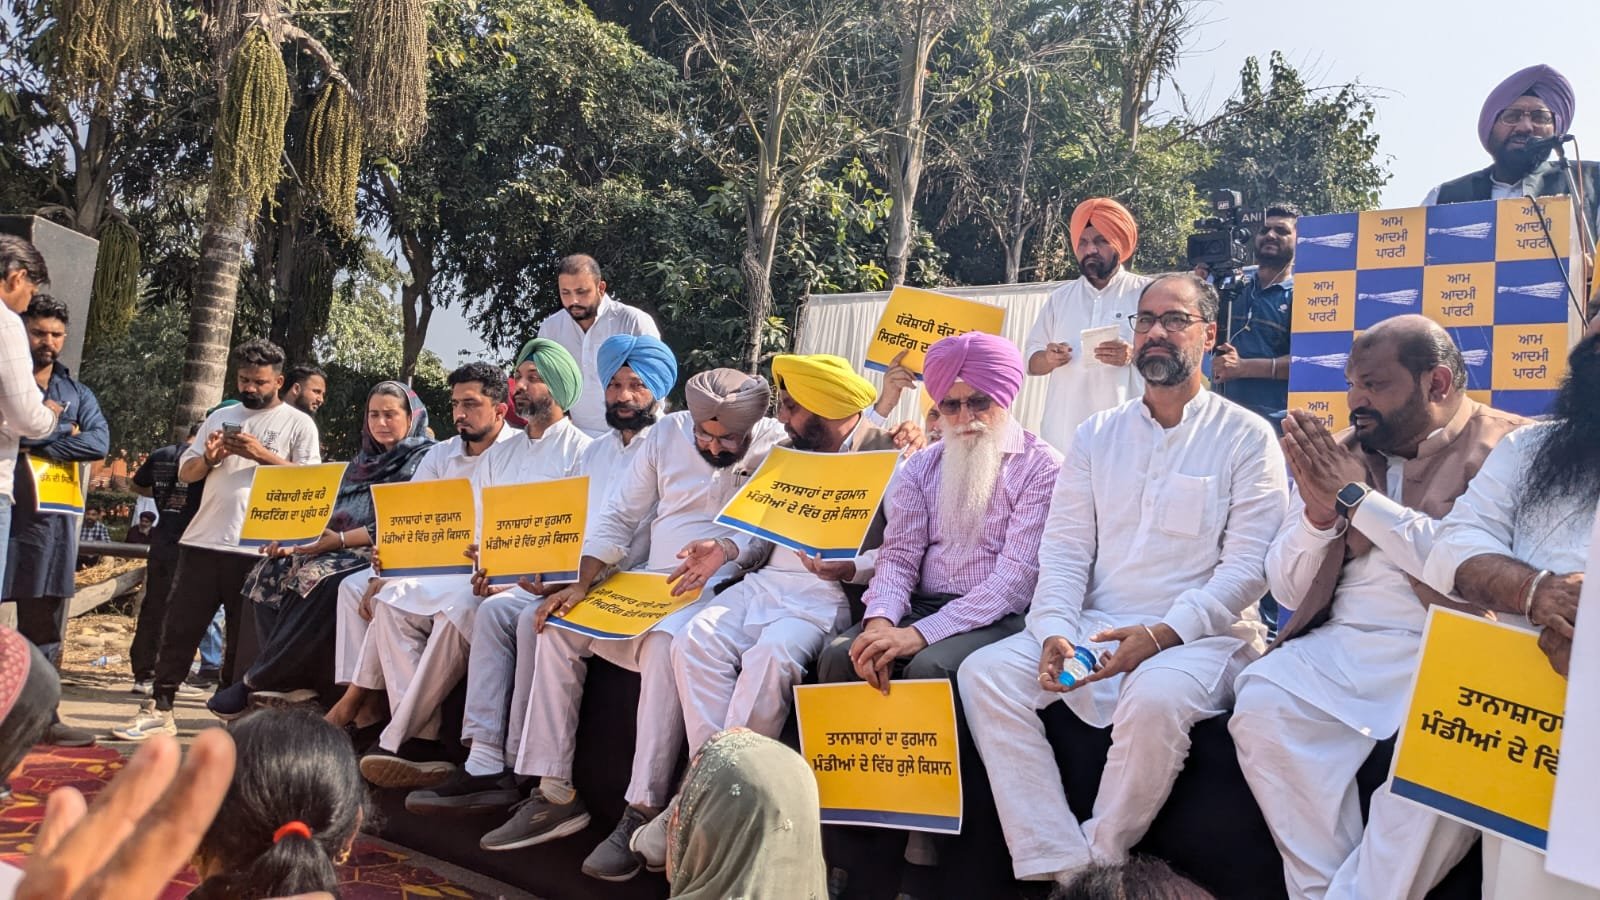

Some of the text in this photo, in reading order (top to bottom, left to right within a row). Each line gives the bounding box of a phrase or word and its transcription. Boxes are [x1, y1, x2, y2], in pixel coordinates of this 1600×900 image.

[1242, 212, 1261, 222] ANI
[1381, 216, 1403, 226] ਆਮ
[1374, 228, 1408, 242] ਆਦਮੀ
[1376, 245, 1405, 258] ਪਾਰਟੀ
[1313, 281, 1334, 290] ਆਮ
[1447, 274, 1470, 284] ਆਮ
[1307, 293, 1338, 306] ਆਦਮੀ
[1440, 286, 1476, 300] ਆਦਮੀ
[1308, 309, 1336, 322] ਪਾਰਟੀ
[1441, 303, 1473, 316] ਪਾਰਟੀ
[937, 323, 956, 336] ਬੰਦ
[1518, 334, 1543, 344] ਆਮ
[1511, 348, 1548, 362] ਆਦਮੀ
[1513, 365, 1546, 378] ਪਾਰਟੀ
[1308, 402, 1329, 411] ਆਮ
[822, 491, 832, 500] ਦਾ
[746, 491, 785, 508] ਮੰਡੀਆਂ
[787, 501, 798, 512] ਦੇ
[840, 508, 870, 520] ਕਿਸਾਨ
[290, 510, 299, 520] ਦਾ
[424, 515, 432, 523] ਦਾ
[534, 517, 543, 526] ਦਾ
[382, 531, 405, 544] ਮੰਡੀਆਂ
[407, 531, 413, 542] ਦੇ
[447, 528, 470, 540] ਕਿਸਾਨ
[486, 536, 512, 549] ਮੰਡੀਆਂ
[514, 535, 520, 548] ਦੇ
[553, 531, 580, 544] ਕਿਸਾਨ
[886, 732, 897, 745] ਦਾ
[1421, 710, 1502, 752] ਮੰਡੀਆਂ
[1508, 736, 1528, 763] ਦੇ
[813, 754, 855, 772] ਮੰਡੀਆਂ
[859, 754, 869, 772] ਦੇ
[918, 755, 951, 775] ਕਿਸਾਨ
